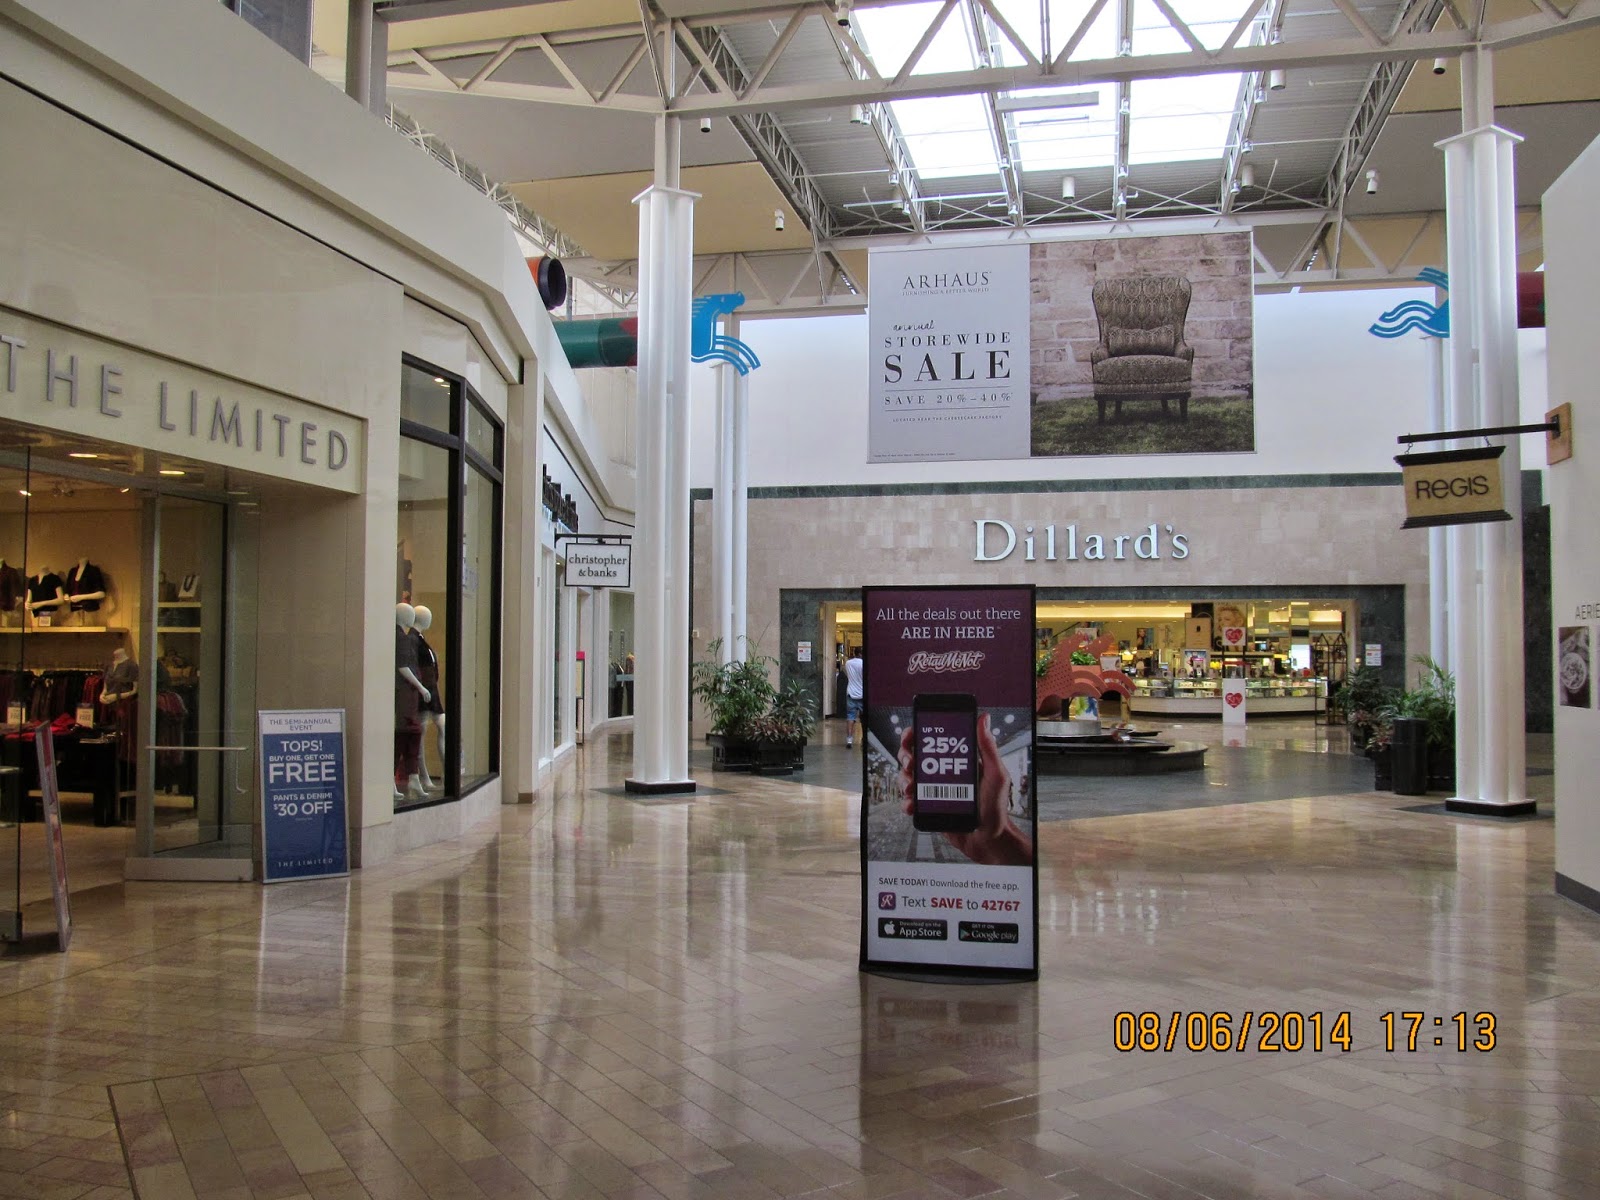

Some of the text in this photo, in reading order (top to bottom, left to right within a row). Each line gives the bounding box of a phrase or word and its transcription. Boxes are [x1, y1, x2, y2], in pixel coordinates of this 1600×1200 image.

[903, 271, 989, 290] ARHAUS
[893, 320, 935, 332] annual
[884, 332, 1011, 348] STOREWIDE
[884, 350, 1011, 383] SALE
[1, 334, 348, 470] THE LIMITED
[884, 395, 926, 406] SAVE
[973, 519, 1190, 561] Dillard's
[568, 553, 628, 568] christopher
[876, 607, 1021, 621] All the deals out there
[901, 626, 995, 640] ARE IN HERE
[908, 650, 986, 675] RetailMeNot
[281, 739, 323, 752] TOPS!
[922, 736, 969, 754] 25%
[285, 754, 303, 762] ONE,
[269, 761, 336, 784] FREE
[921, 757, 968, 775] OFF
[273, 792, 333, 802] PANTS & DENIM!
[273, 801, 333, 817] $30 OFF
[278, 858, 333, 868] THE LIMITED
[878, 877, 1020, 892] SAVE TODAY! Download the free app.
[901, 896, 1020, 912] Text SAVE to 42767
[900, 927, 942, 938] App Store
[971, 930, 1017, 941] Google play
